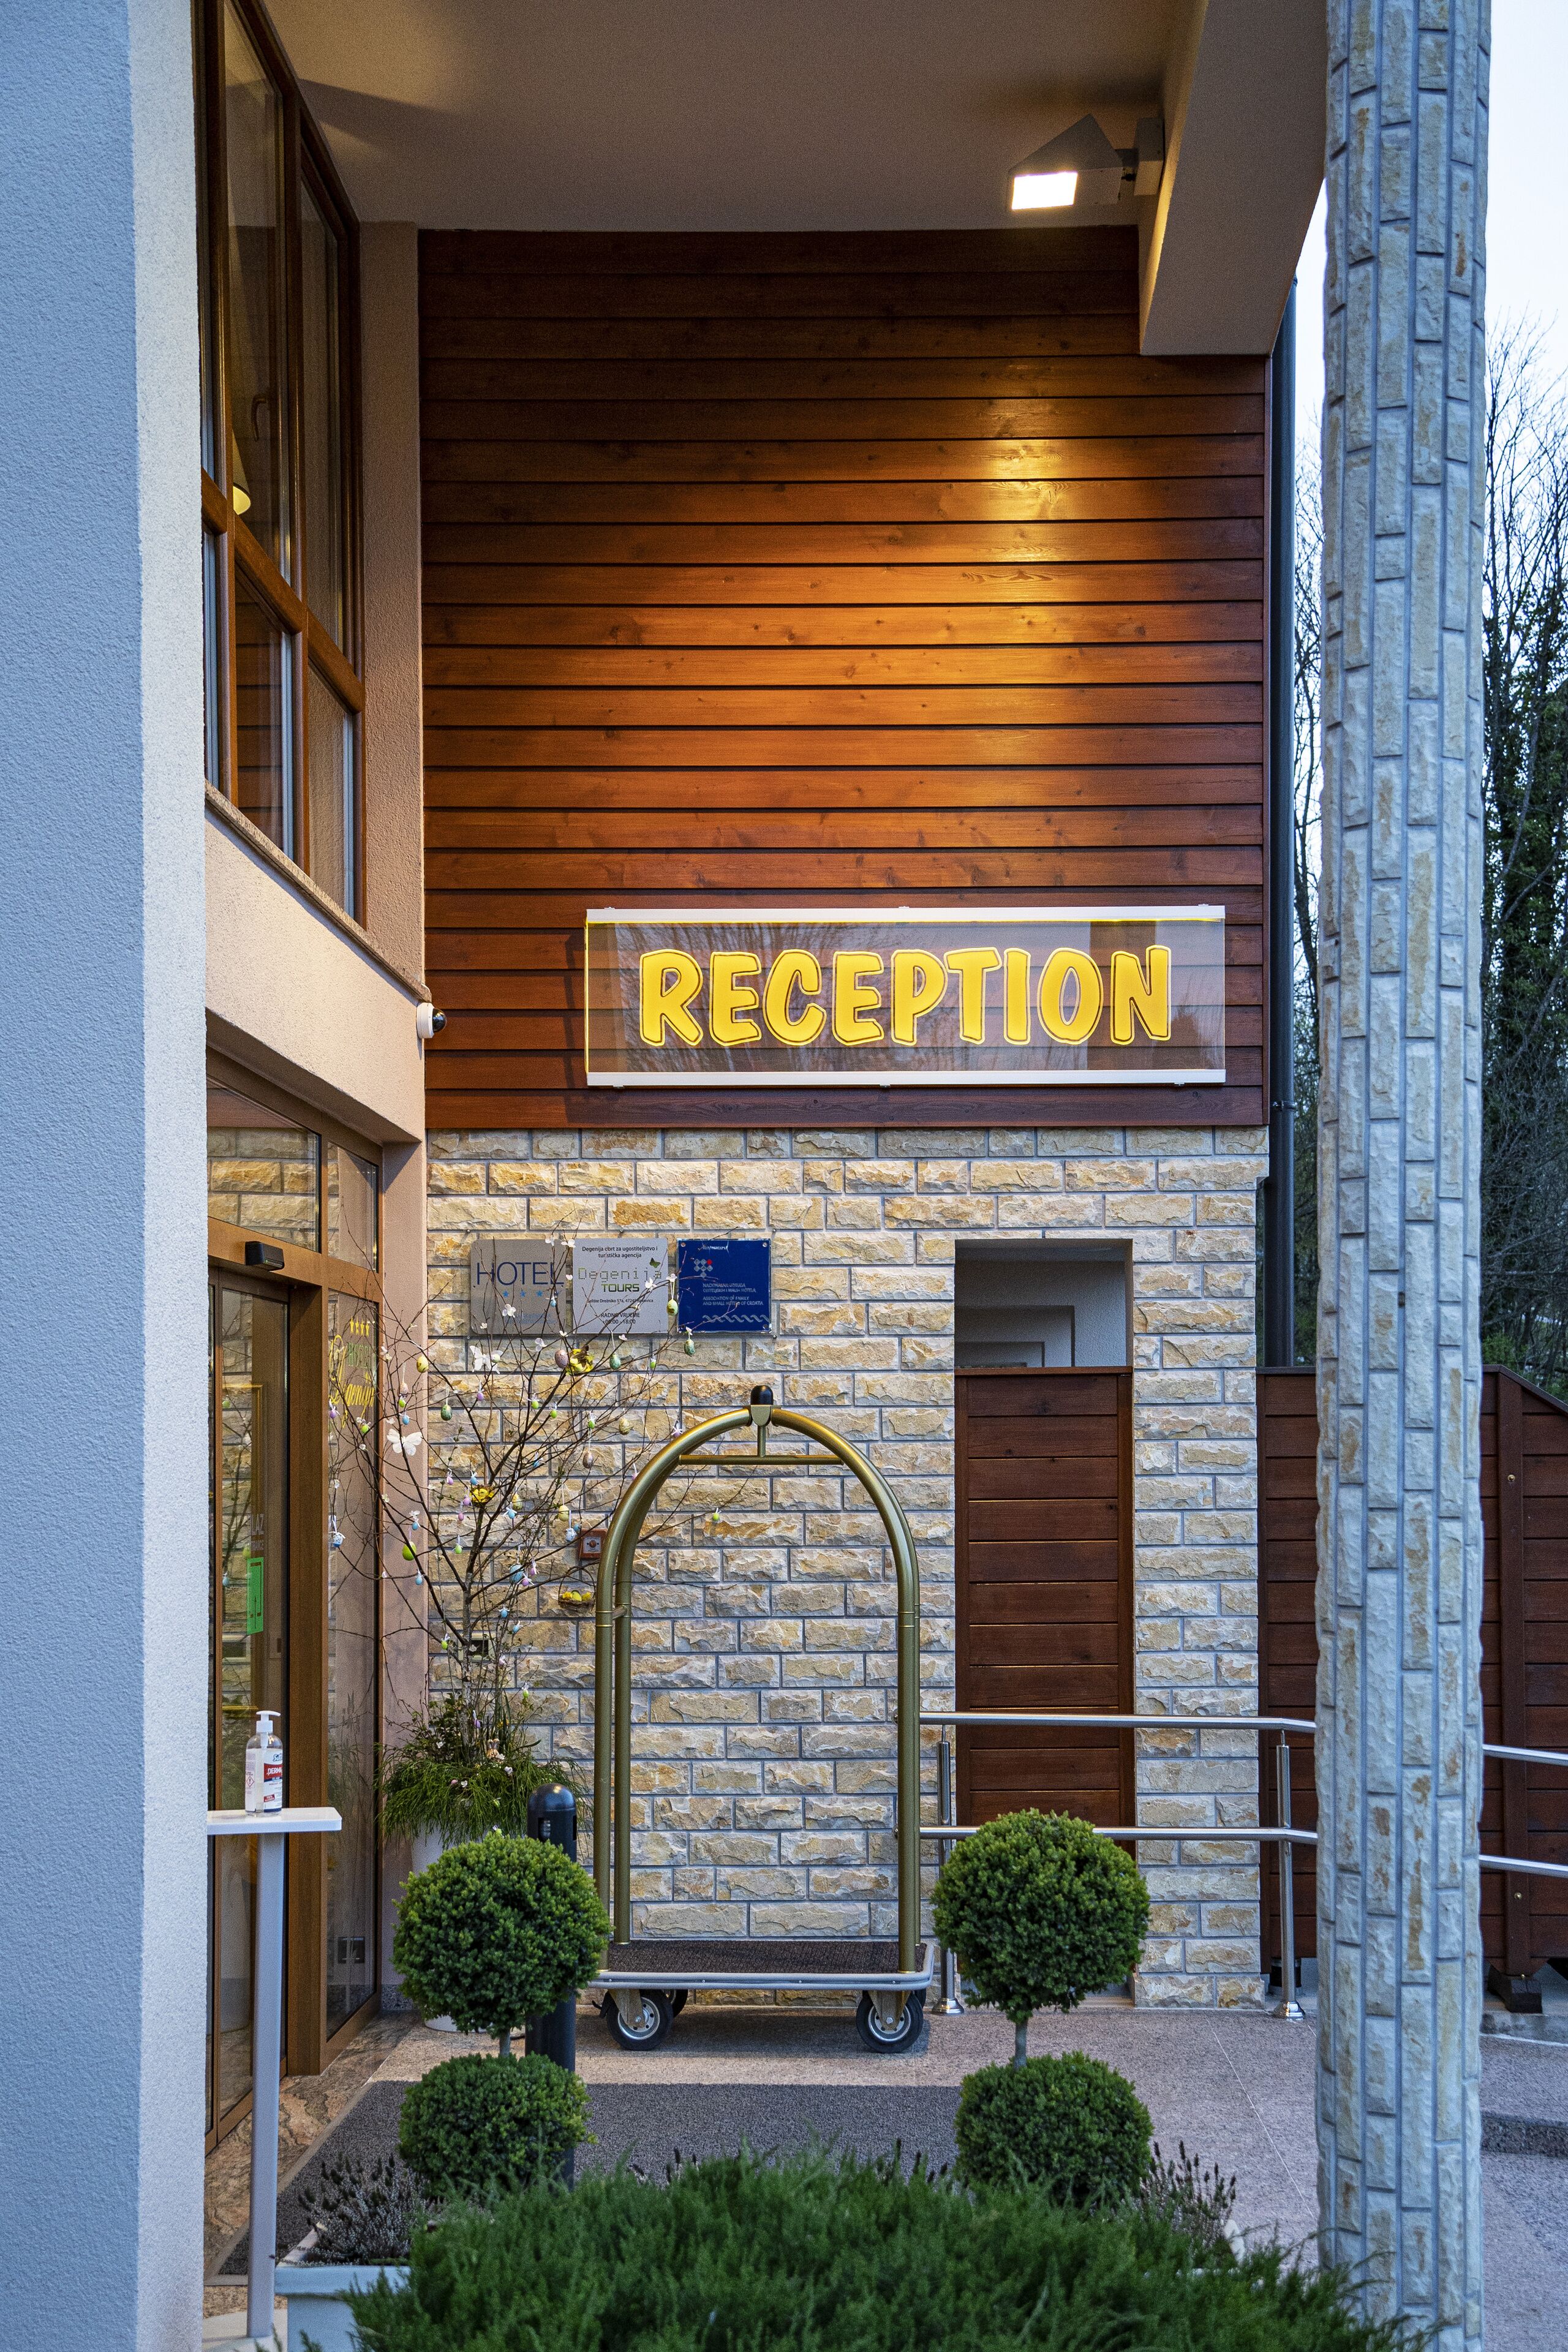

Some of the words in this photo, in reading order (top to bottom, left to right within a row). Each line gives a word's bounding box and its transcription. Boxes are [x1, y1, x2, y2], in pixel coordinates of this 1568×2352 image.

[639, 945, 1172, 1046] RECEPTION
[477, 1261, 565, 1286] HOTEL
[578, 1267, 662, 1283] Degenija
[601, 1283, 639, 1292] TOURS
